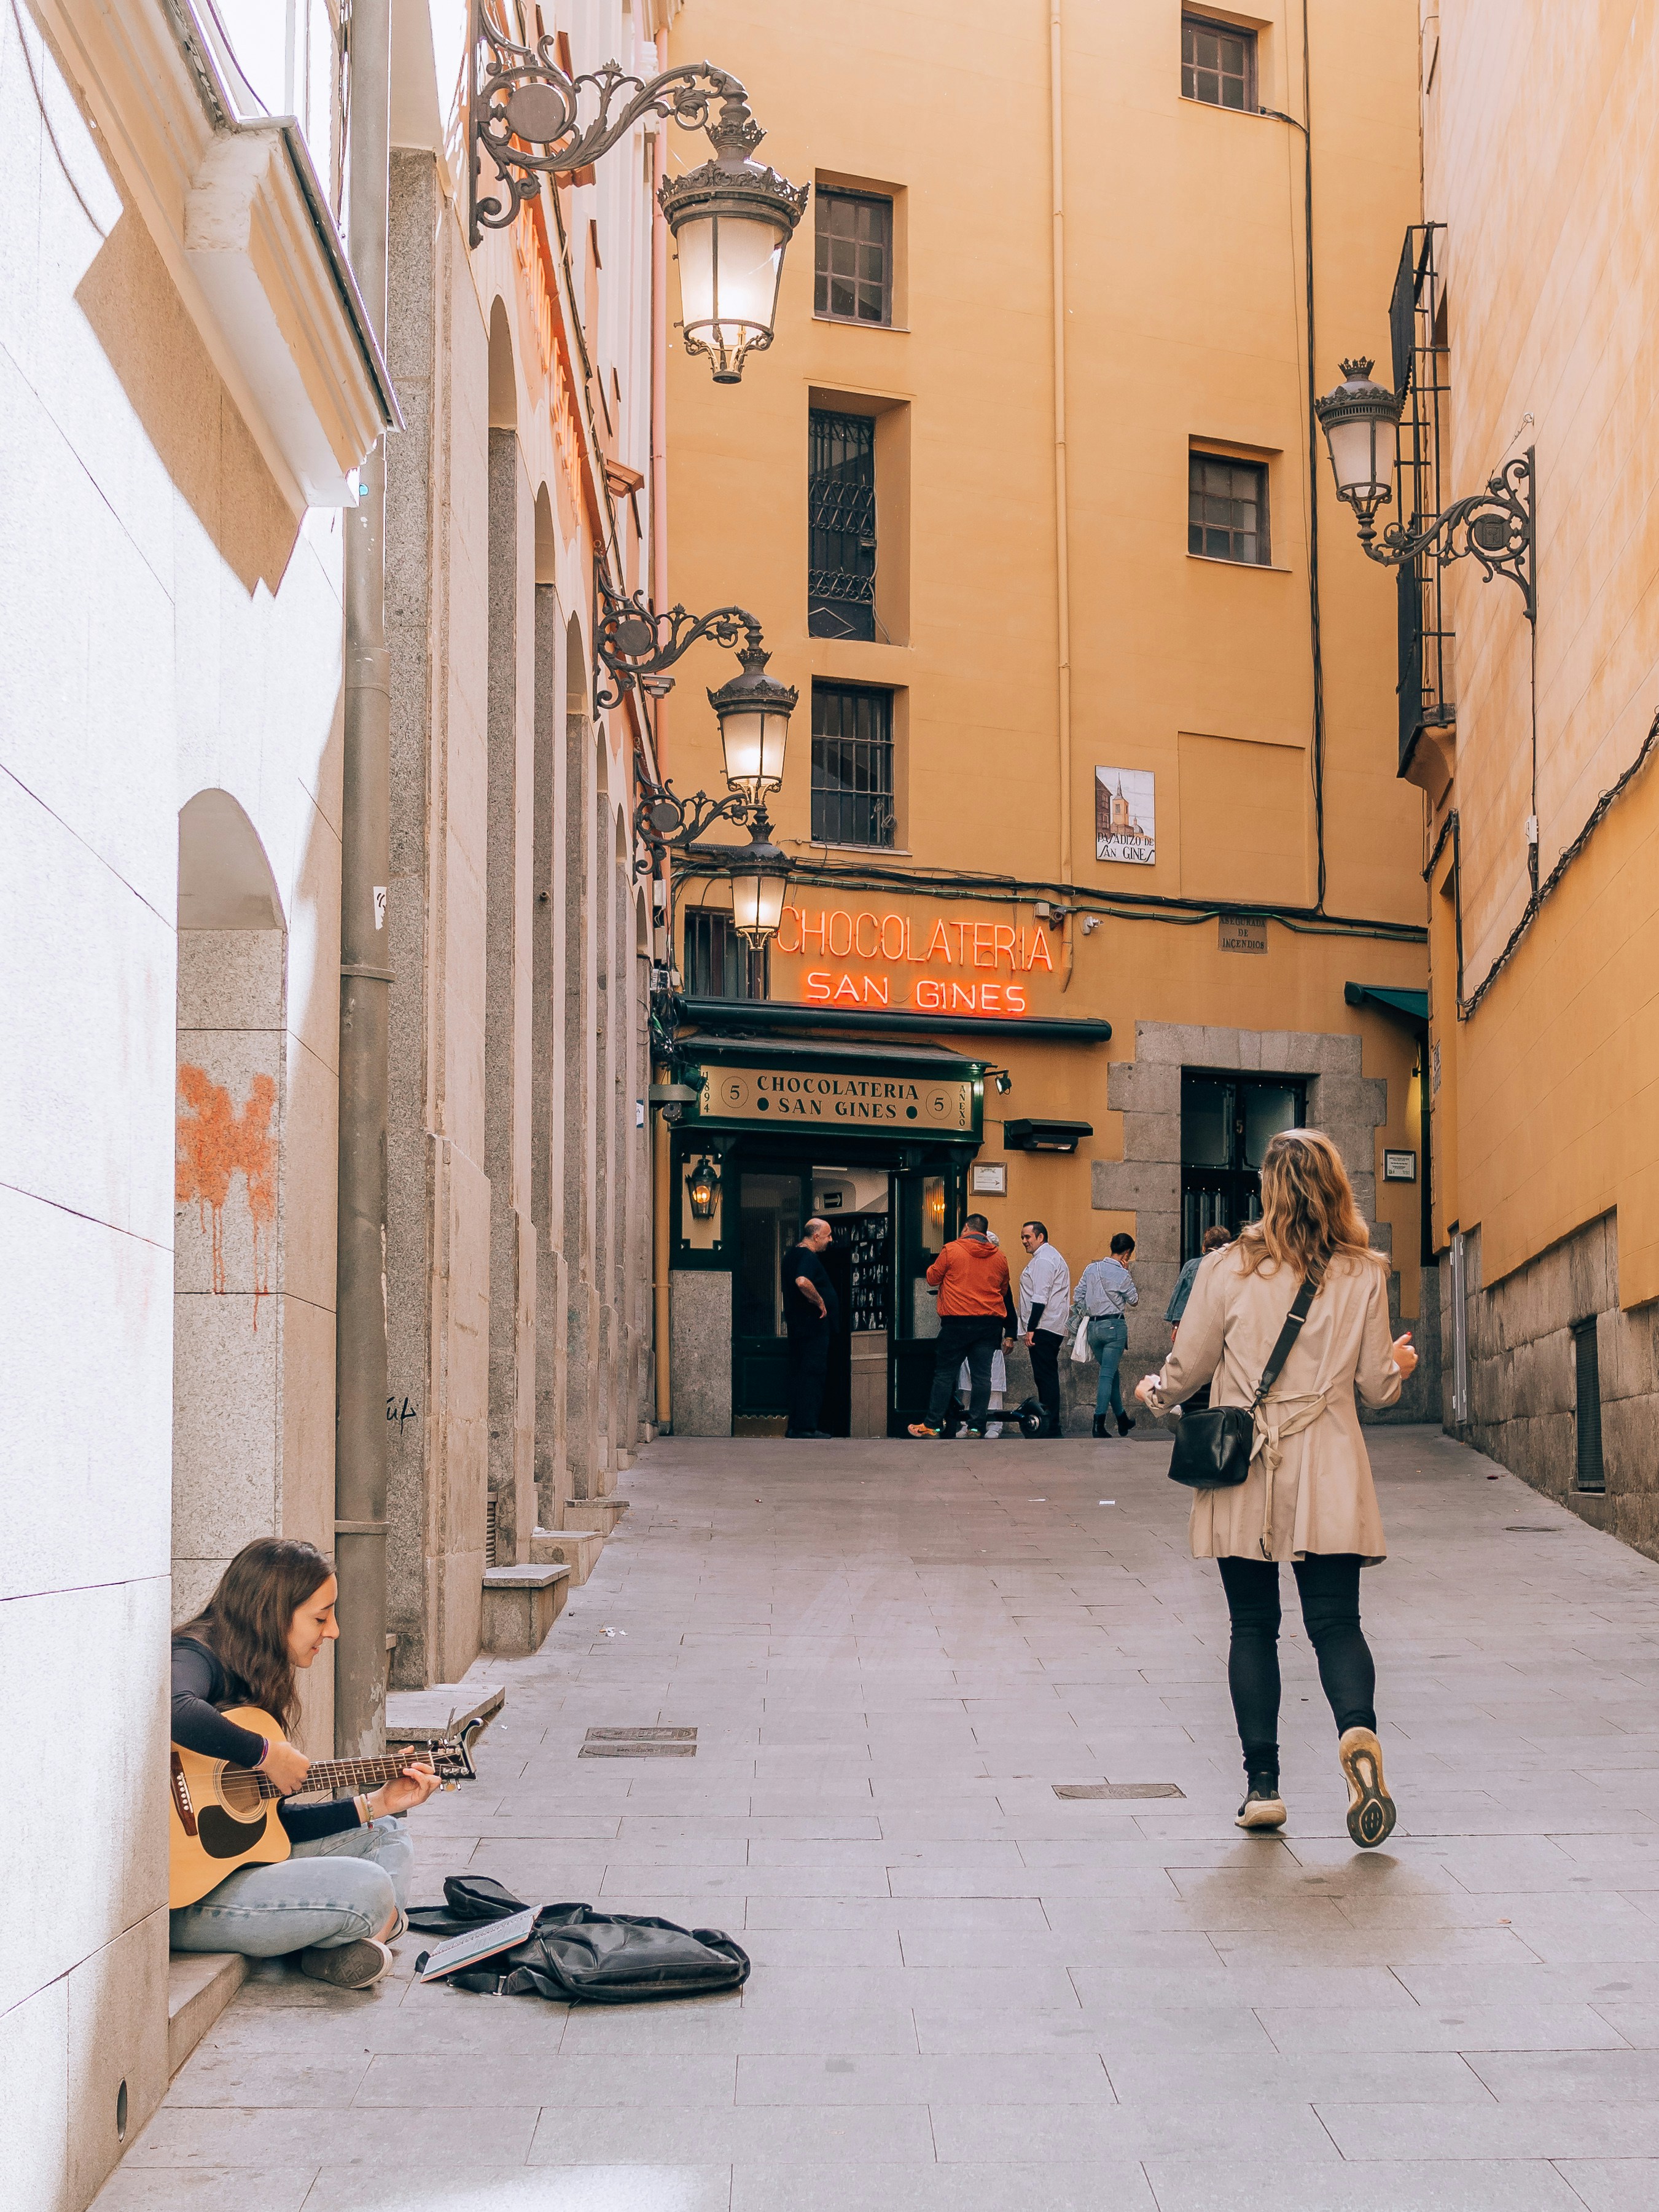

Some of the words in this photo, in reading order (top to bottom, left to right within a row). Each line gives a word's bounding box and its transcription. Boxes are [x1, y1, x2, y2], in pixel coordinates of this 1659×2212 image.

[1098, 832, 1141, 846] PASADIZO
[1144, 837, 1154, 846] DE
[1098, 845, 1117, 858] SAN
[1123, 846, 1155, 862] GINES
[776, 905, 1053, 972] CHOCOLATERIA
[1238, 928, 1249, 937] DE
[807, 972, 888, 1005] SAN
[916, 980, 1026, 1012] GINES
[730, 1085, 740, 1100] 5
[757, 1076, 919, 1100] CHOCOLATERIA
[778, 1097, 822, 1116] SAN
[835, 1101, 897, 1119] GINES
[934, 1097, 944, 1112] 5
[1236, 1120, 1243, 1133] 5
